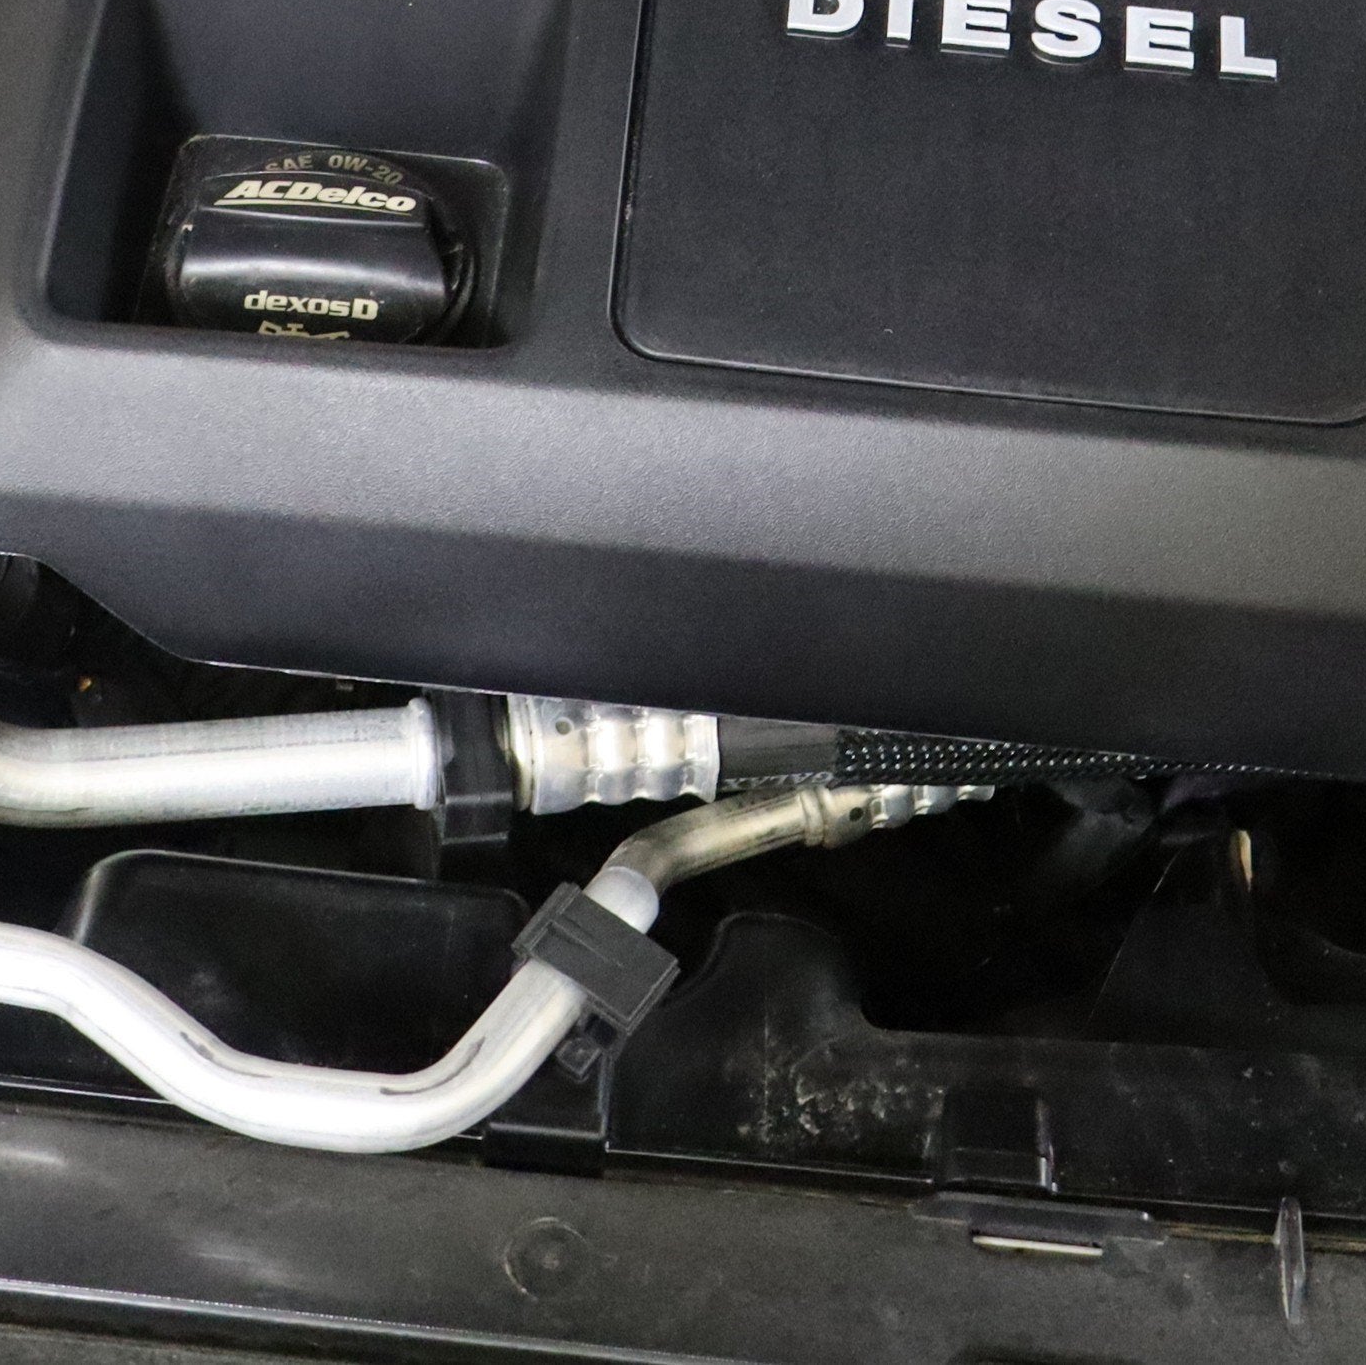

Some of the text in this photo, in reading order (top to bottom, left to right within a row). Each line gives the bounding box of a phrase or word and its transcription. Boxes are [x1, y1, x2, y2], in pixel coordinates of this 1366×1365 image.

[264, 153, 403, 186] SAE 0W-20
[215, 179, 417, 215] ACDelco
[243, 289, 379, 321] dexosD
